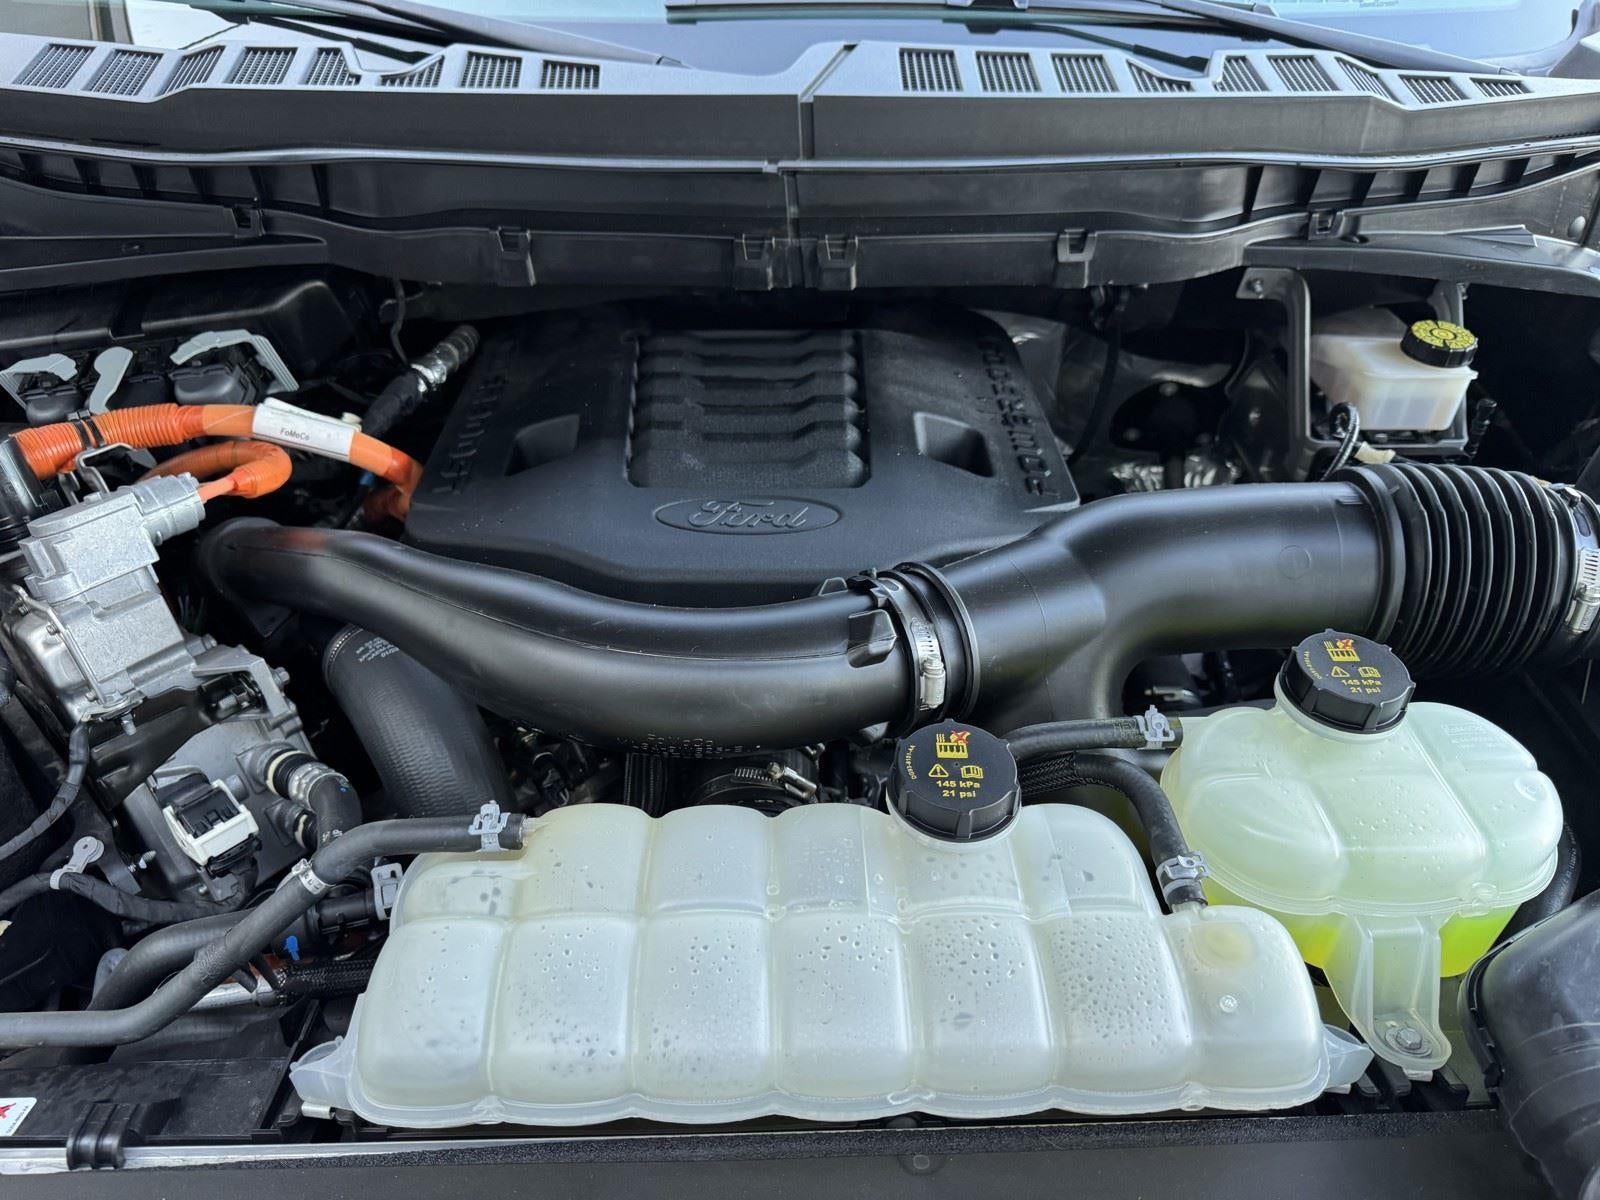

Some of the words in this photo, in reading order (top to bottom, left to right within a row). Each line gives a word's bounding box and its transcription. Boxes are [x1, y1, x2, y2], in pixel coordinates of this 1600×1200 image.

[280, 427, 310, 441] FoMoCo
[688, 500, 809, 529] Ford
[960, 790, 976, 799] psi
